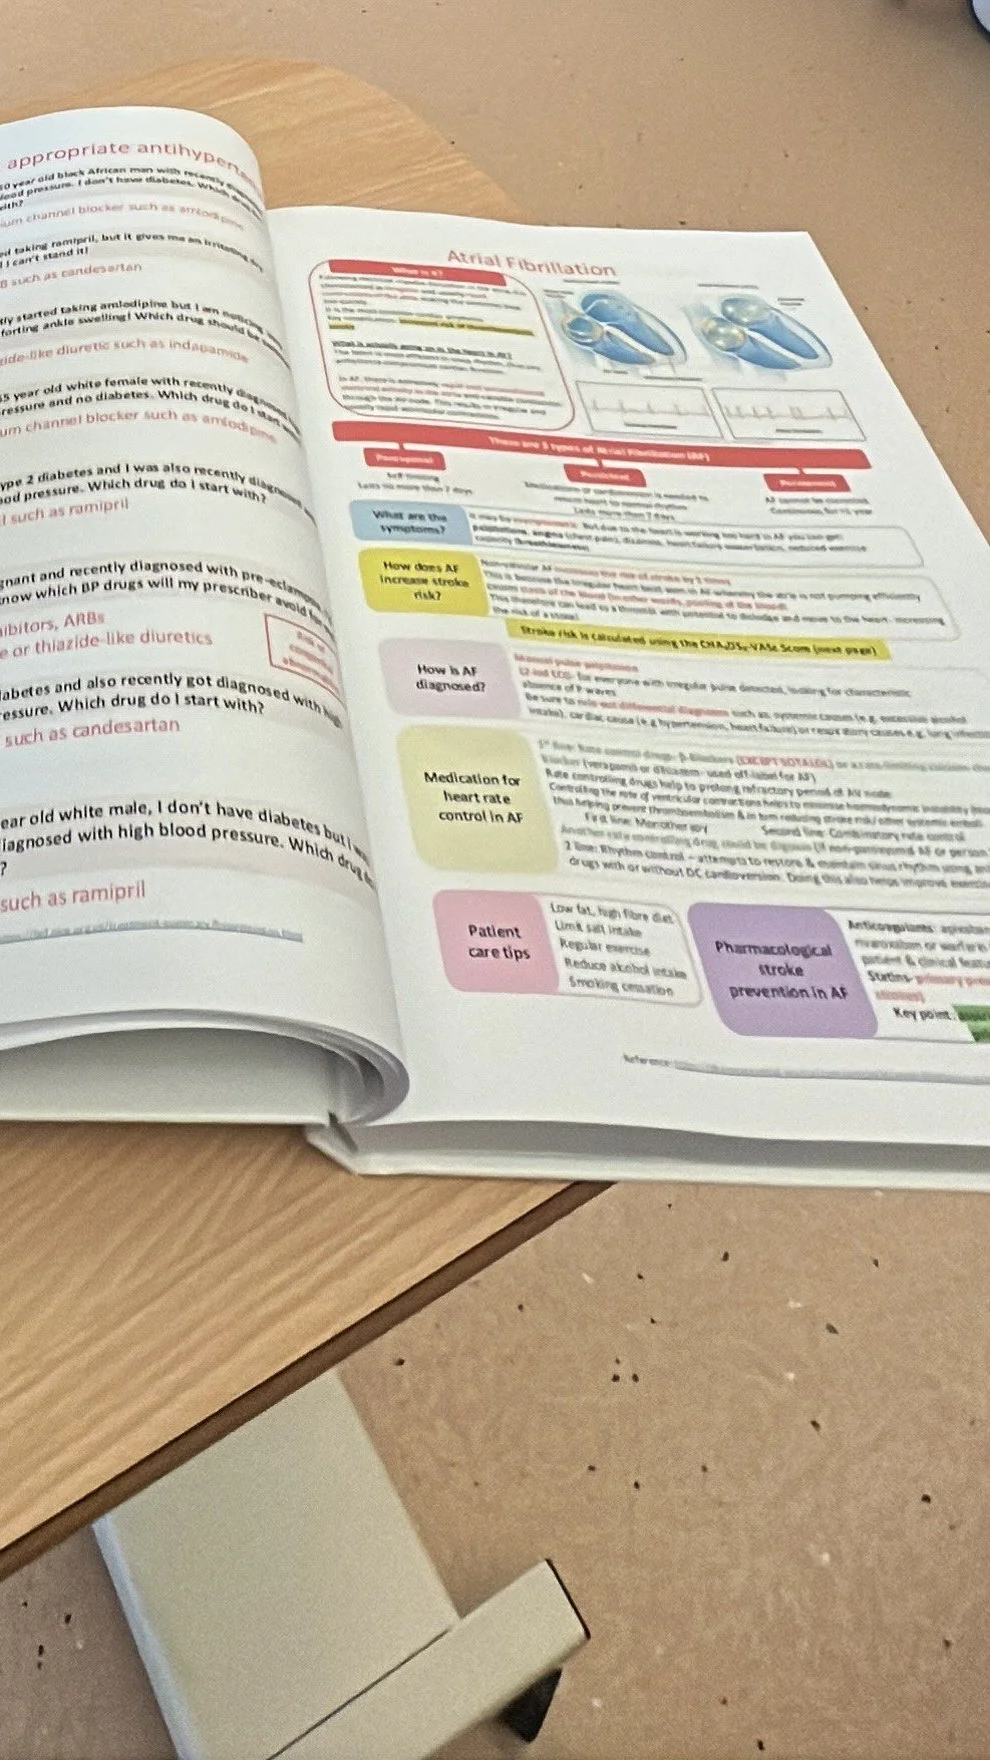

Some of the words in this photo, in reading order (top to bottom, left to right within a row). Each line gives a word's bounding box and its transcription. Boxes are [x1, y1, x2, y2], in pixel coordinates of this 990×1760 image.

[7, 143, 129, 170] appropriate
[447, 249, 501, 267] Atrial
[505, 256, 617, 277] Fibrillation
[372, 509, 404, 521] What
[408, 512, 426, 521] are
[428, 511, 447, 522] the
[380, 523, 446, 535] symptoms?
[39, 567, 65, 582] and
[69, 560, 126, 576] recently
[130, 560, 203, 574] diagnosed
[206, 561, 238, 577] with
[383, 561, 412, 572] How
[414, 562, 442, 574] does
[445, 563, 459, 574] AF
[380, 575, 428, 586] increase
[432, 576, 469, 588] stroke
[35, 584, 77, 599] which
[81, 581, 99, 594] BP
[103, 578, 144, 592] drugs
[148, 577, 174, 589] will
[178, 578, 198, 592] my
[203, 580, 272, 602] prescriber
[275, 596, 307, 617] avoid
[413, 590, 441, 601] risk?
[64, 611, 105, 627] ARBs
[12, 646, 30, 658] or
[140, 629, 213, 645] diuretics
[417, 664, 446, 676] How
[450, 665, 461, 676] is
[462, 666, 478, 677] AF
[55, 679, 81, 693] and
[87, 676, 116, 690] also
[120, 673, 182, 687] recently
[186, 675, 212, 689] got
[216, 676, 290, 702] diagnosed
[292, 692, 322, 714] with
[415, 680, 486, 693] diagnosed?
[58, 697, 106, 713] Which
[111, 693, 146, 708] drug
[150, 692, 171, 705] do
[184, 694, 219, 708] start
[223, 698, 265, 715] with?
[5, 728, 43, 746] such
[49, 726, 68, 741] as
[72, 718, 180, 738] candesartan
[424, 771, 499, 786] Medication
[503, 774, 520, 786] for
[443, 790, 480, 803] heart
[483, 794, 511, 805] rate
[30, 809, 54, 825] old
[59, 804, 103, 822] white
[109, 801, 152, 817] male,
[168, 799, 211, 815] don't
[216, 801, 253, 820] have
[258, 808, 321, 835] diabetes
[323, 823, 347, 846] but
[439, 809, 488, 822] control
[491, 811, 504, 823] in
[506, 812, 523, 823] AF
[78, 824, 113, 841] with
[118, 822, 154, 842] high
[159, 822, 206, 838] blood
[211, 826, 284, 849] pressure.
[289, 837, 334, 863] Which
[338, 853, 364, 882] drug
[0, 891, 41, 913] such
[48, 893, 67, 907] as
[72, 879, 145, 905] ramipril
[551, 902, 573, 914] Low
[598, 905, 621, 920] high
[623, 908, 649, 922] fibre
[469, 924, 522, 939] Patient
[469, 946, 500, 959] care
[503, 945, 531, 962] tips
[715, 940, 833, 958] Pharmacological
[759, 963, 804, 977] stroke
[569, 976, 619, 994] Smoking
[729, 985, 810, 999] prevention
[812, 986, 827, 999] in
[830, 986, 848, 1000] AF
